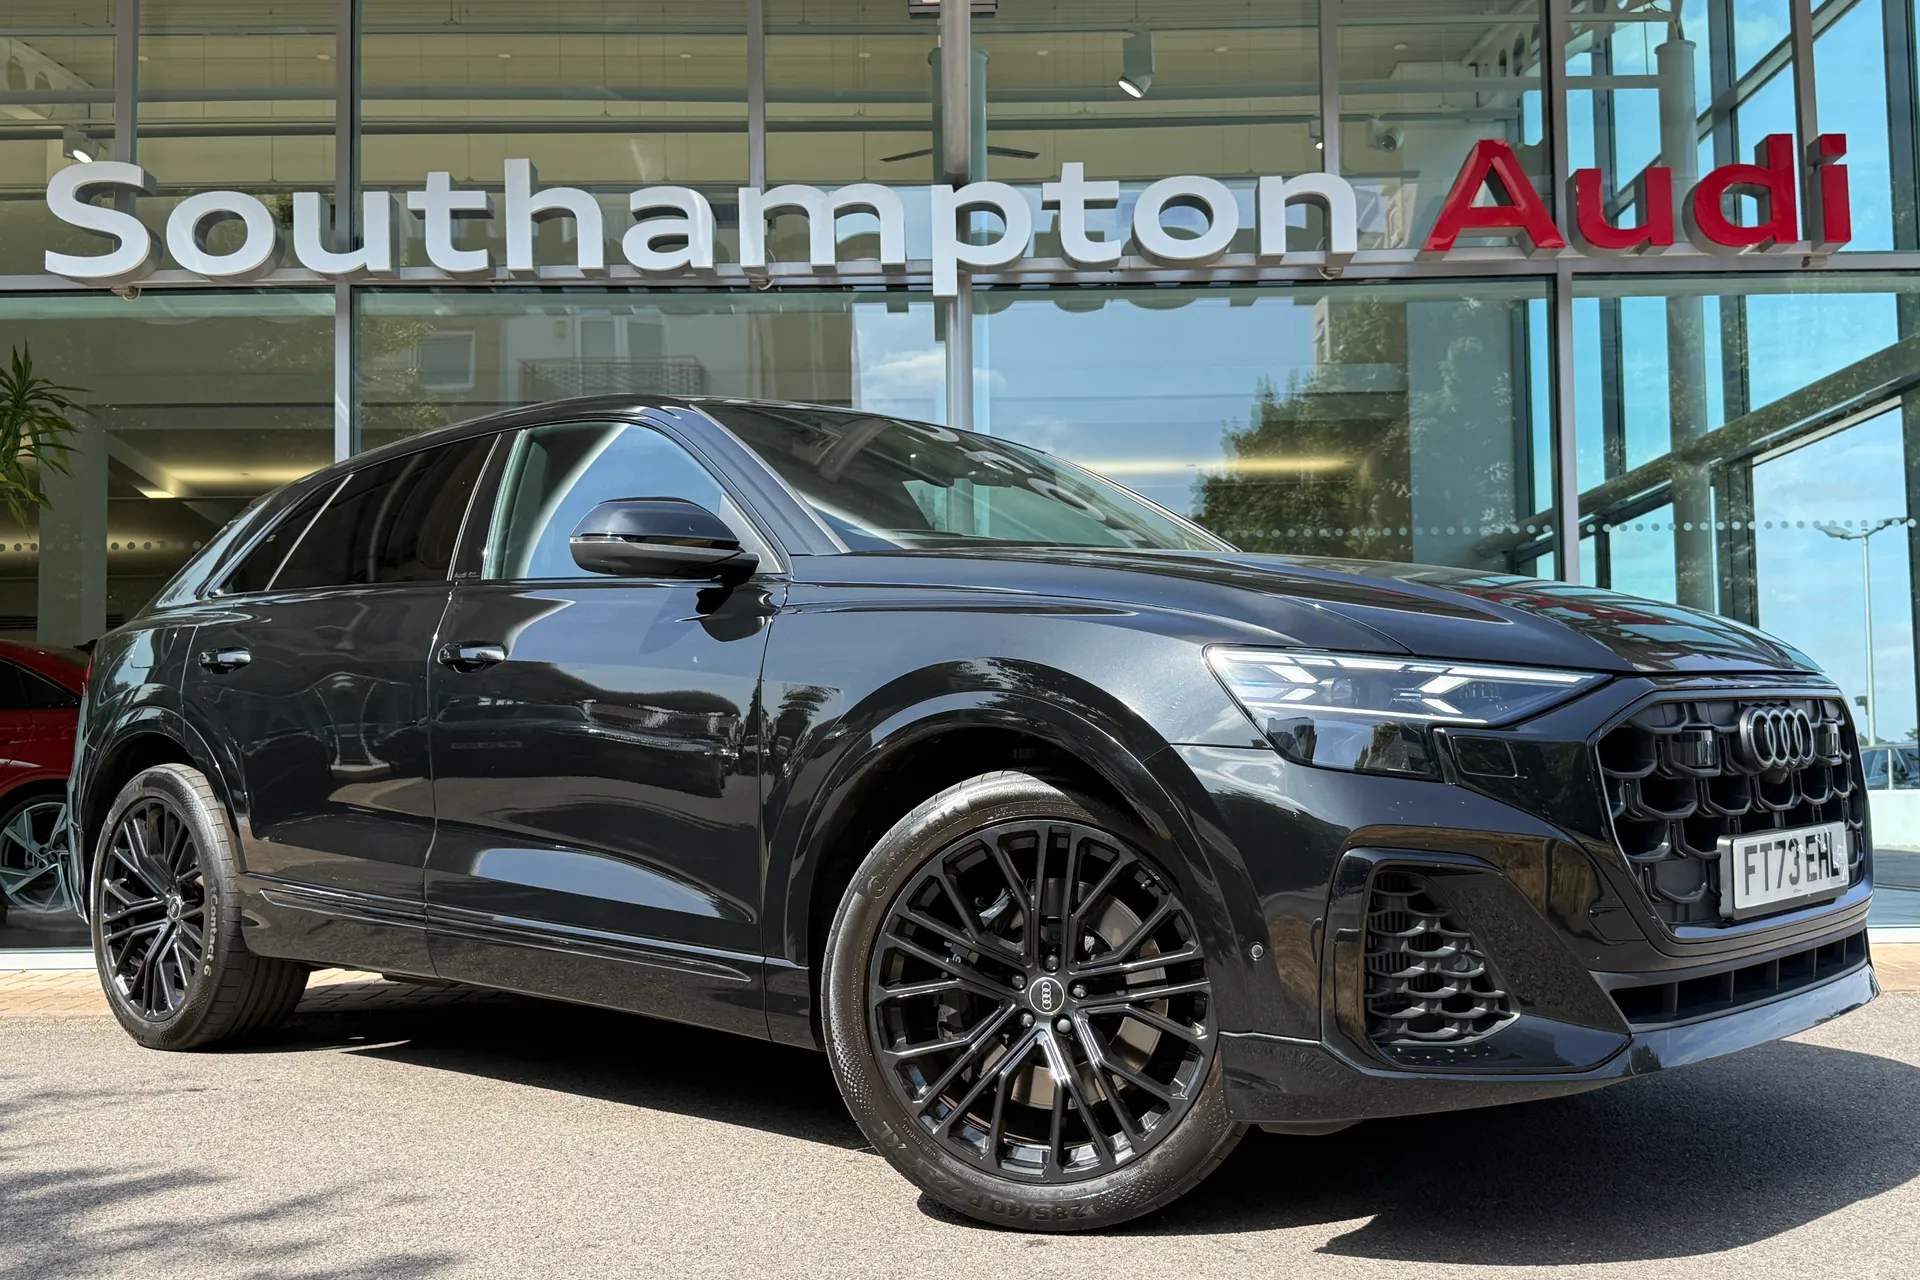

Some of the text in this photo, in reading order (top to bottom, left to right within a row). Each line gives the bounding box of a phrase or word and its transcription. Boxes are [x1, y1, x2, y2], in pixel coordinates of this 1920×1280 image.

[45, 133, 1852, 298] Southampton Audi
[1744, 831, 1840, 896] FT73 EHL
[203, 964, 212, 977] 6
